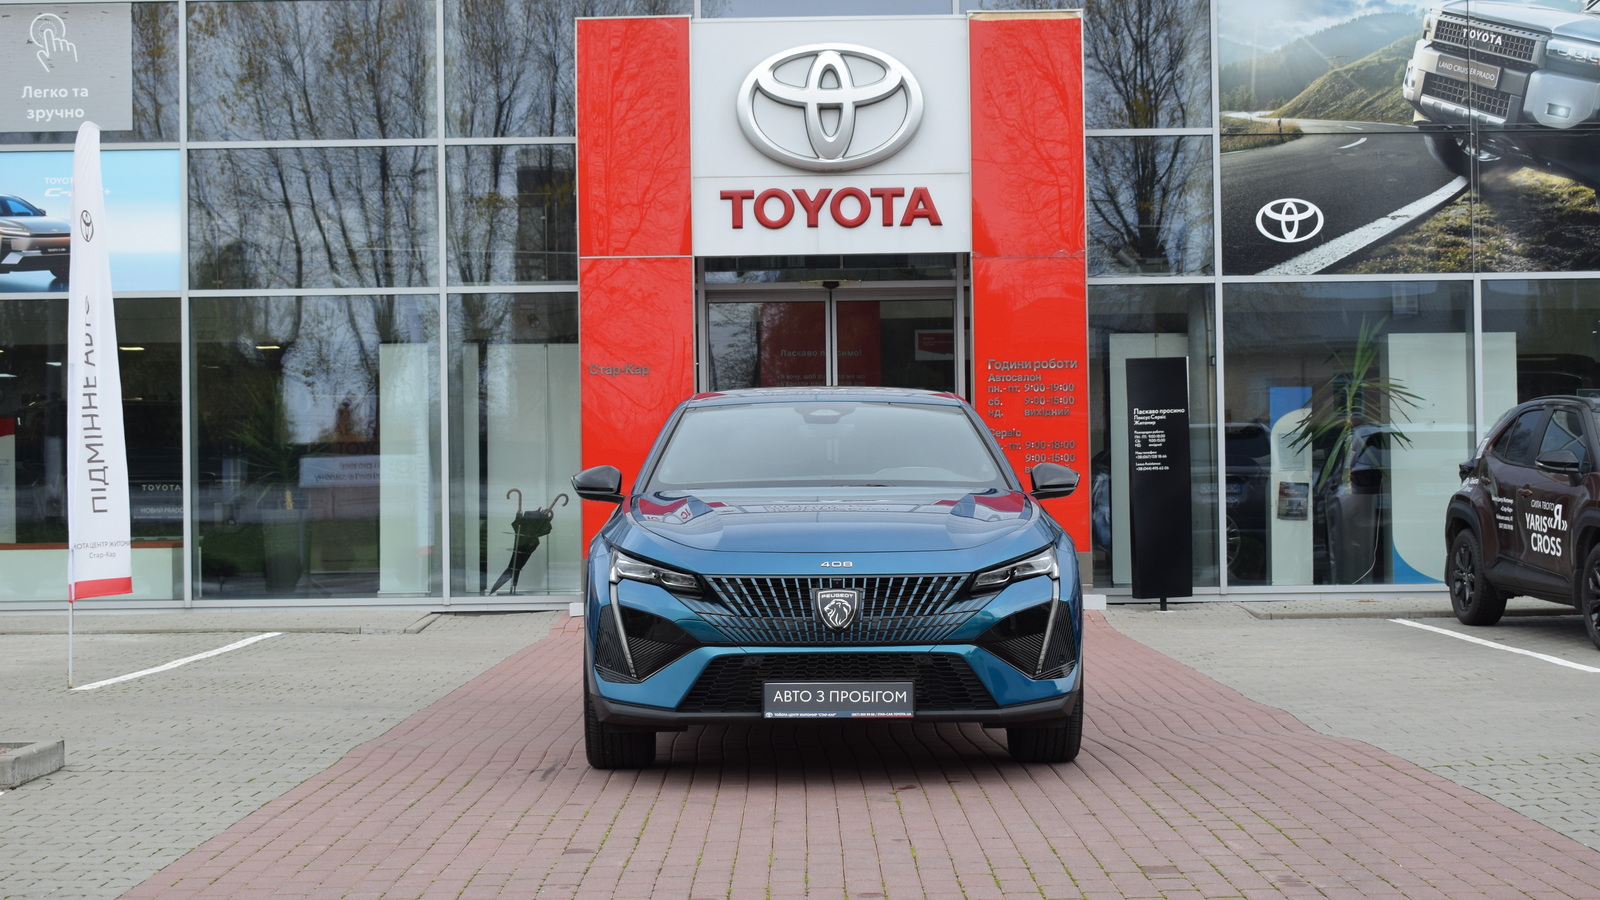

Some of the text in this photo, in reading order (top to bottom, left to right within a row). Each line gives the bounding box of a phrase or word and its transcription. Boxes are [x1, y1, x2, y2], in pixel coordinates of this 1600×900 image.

[1463, 28, 1502, 45] TOYOTA
[1438, 61, 1495, 81] LAND CRUISER PRADO
[22, 86, 89, 98] Легко та
[27, 107, 85, 121] зручно
[44, 177, 73, 185] TOYOT
[720, 187, 942, 229] TOYOTA
[780, 349, 862, 357] Ласкаво псимо!
[589, 364, 650, 377] Стар-Кар
[987, 358, 1078, 371] Години роботи
[988, 374, 1041, 382] Автосалон
[1024, 384, 1074, 392] 9:00-19:00
[988, 396, 1074, 406] сб. 9:00-15:00
[1024, 407, 1070, 417] вихідний
[989, 428, 1022, 439] Сервіс
[82, 376, 109, 513] ПІДМІННЕ
[1025, 441, 1076, 449] 9:00-18:00
[1025, 454, 1076, 462] 9:00-15:00
[141, 484, 182, 492] TOYOTA
[1525, 512, 1548, 533] YARIS
[1531, 532, 1562, 557] CROSS
[773, 690, 812, 703] АВТО
[829, 690, 907, 703] ПРОБІГОМ
